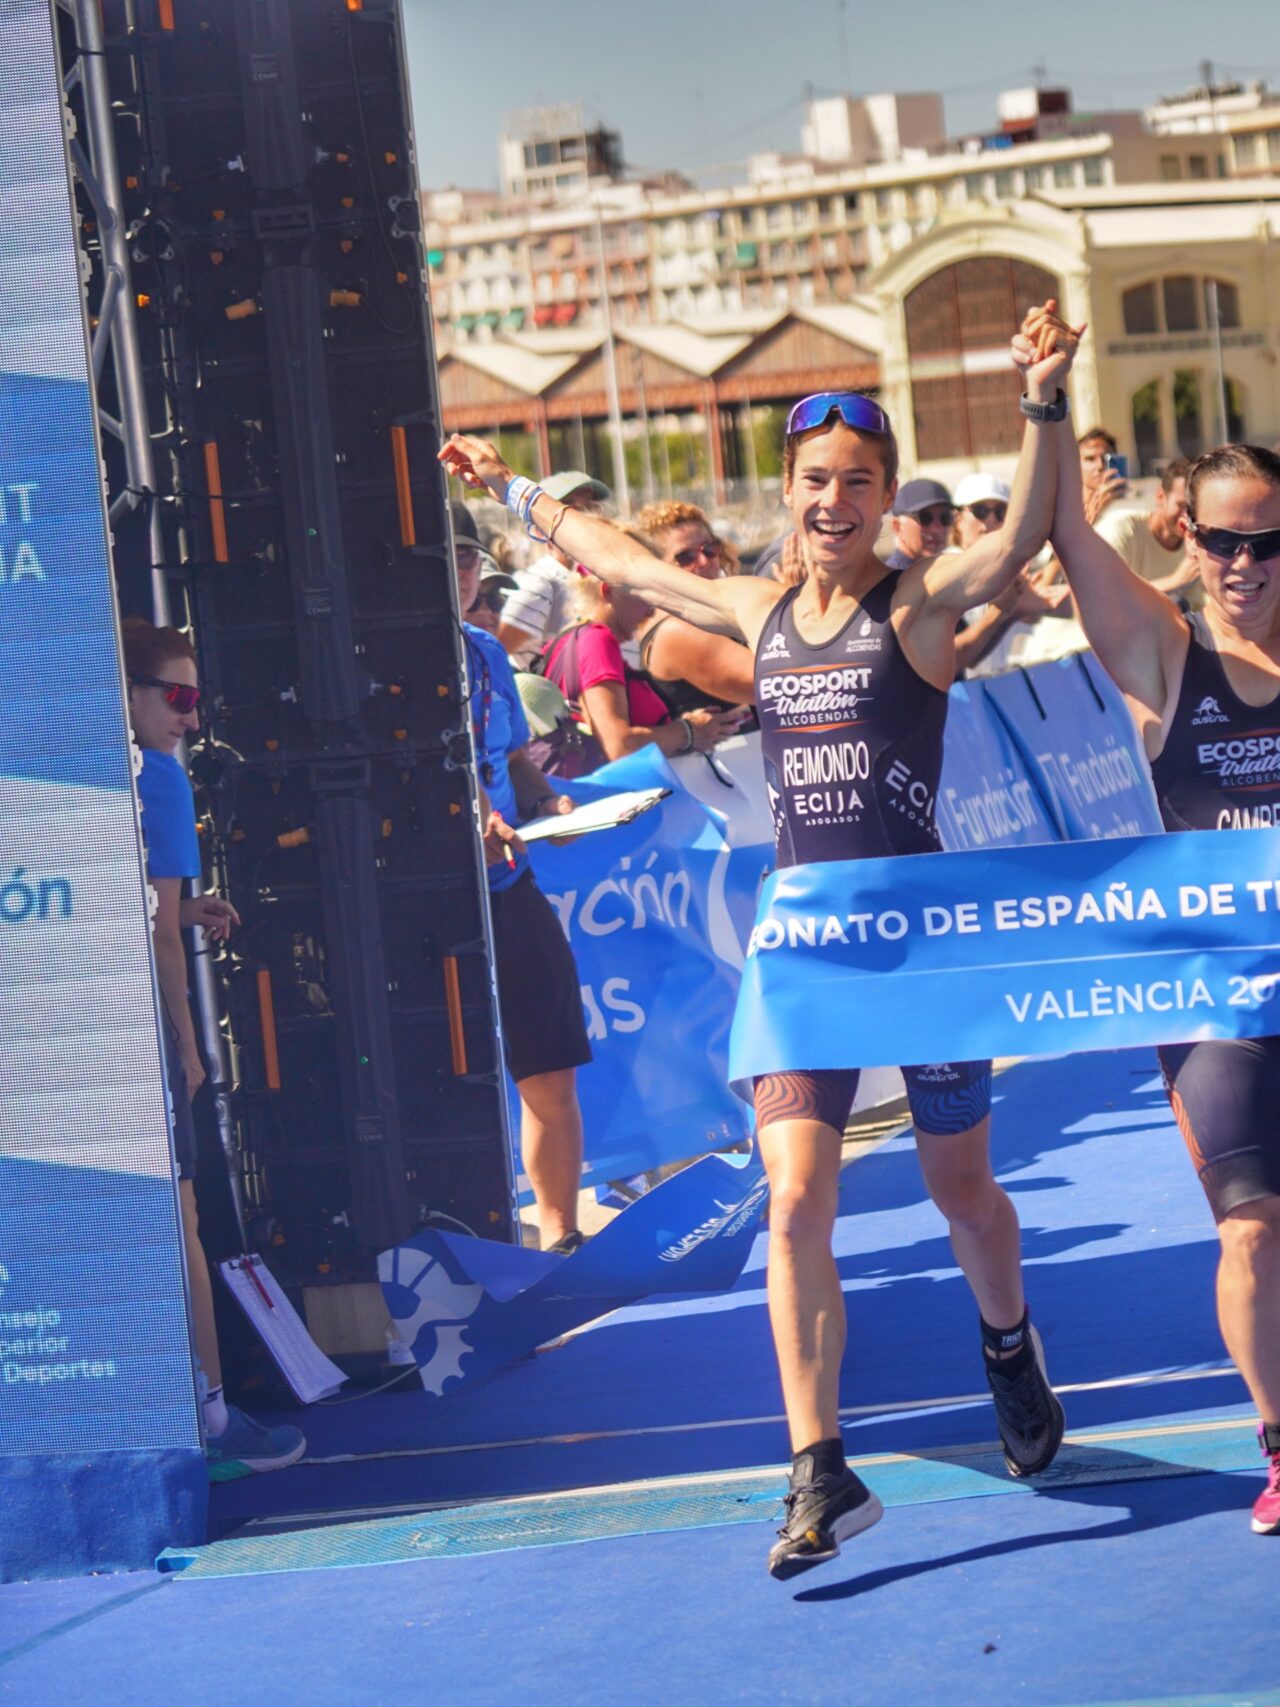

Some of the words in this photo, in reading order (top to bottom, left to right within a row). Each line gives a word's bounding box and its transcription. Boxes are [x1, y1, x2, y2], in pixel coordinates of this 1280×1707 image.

[759, 668, 873, 700] ECOSPORT
[780, 710, 858, 727] ALCOBENDAS
[783, 741, 870, 788] REIMONDO
[794, 788, 865, 815] ECIJA
[805, 815, 861, 826] ABOGADOS
[922, 902, 982, 937] DE
[994, 881, 1168, 931] ESPAÑA
[1178, 883, 1237, 918] DE
[1005, 978, 1216, 1023] VALÈNCIA
[3, 1359, 116, 1385] Deportes
